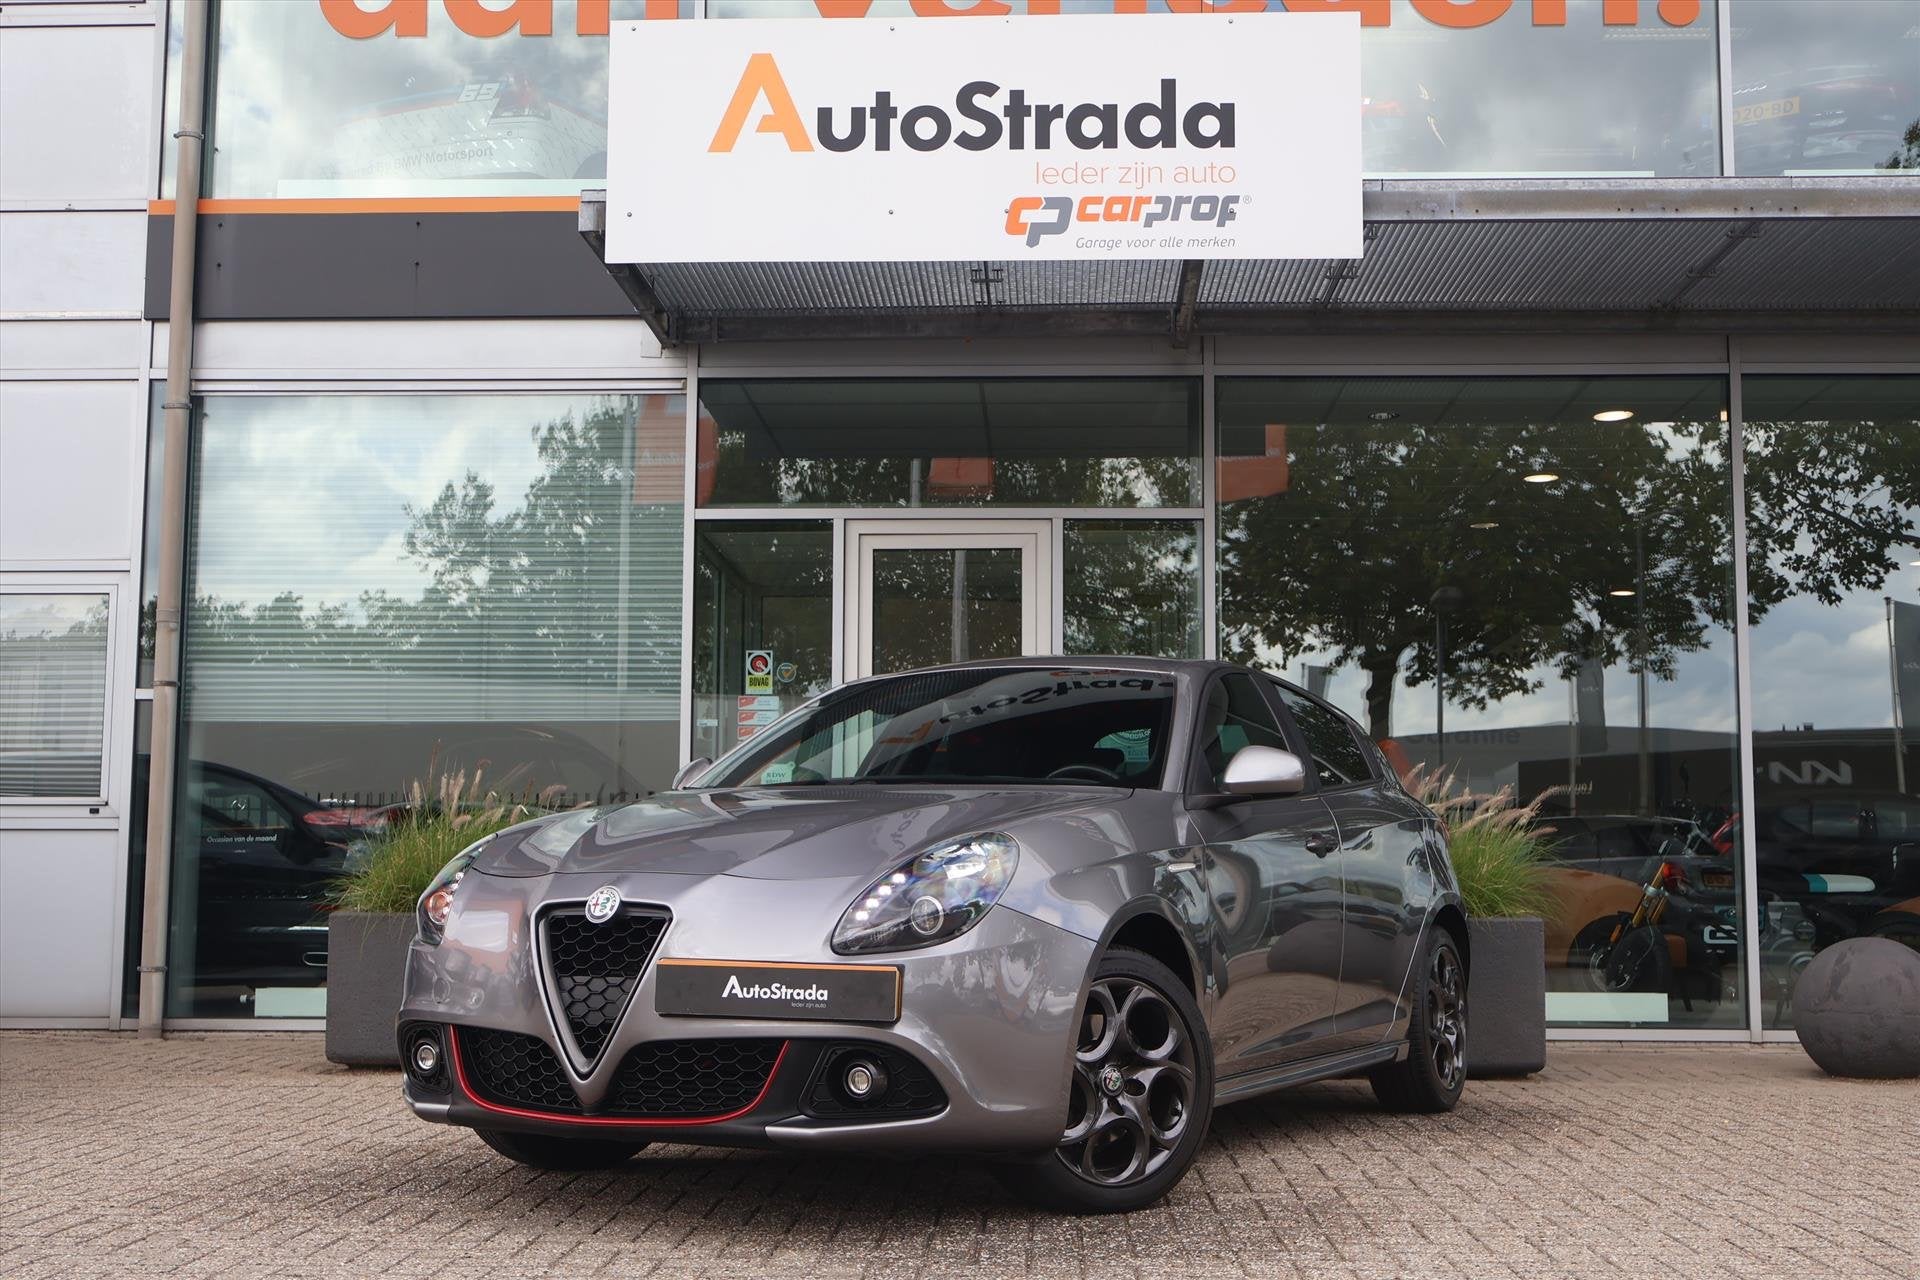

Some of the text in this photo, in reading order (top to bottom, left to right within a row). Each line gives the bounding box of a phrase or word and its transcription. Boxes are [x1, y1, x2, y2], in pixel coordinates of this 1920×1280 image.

[458, 82, 500, 102] 69
[707, 53, 1236, 153] AutoStrada
[425, 147, 494, 164] Motorsport
[1036, 161, 1236, 190] Ieder zijn auto
[1076, 195, 1240, 228] carprof
[1076, 236, 1236, 251] Garage voor alle merken
[749, 676, 769, 687] BOVAG
[247, 834, 254, 842] de
[721, 975, 828, 1001] AutoStrada
